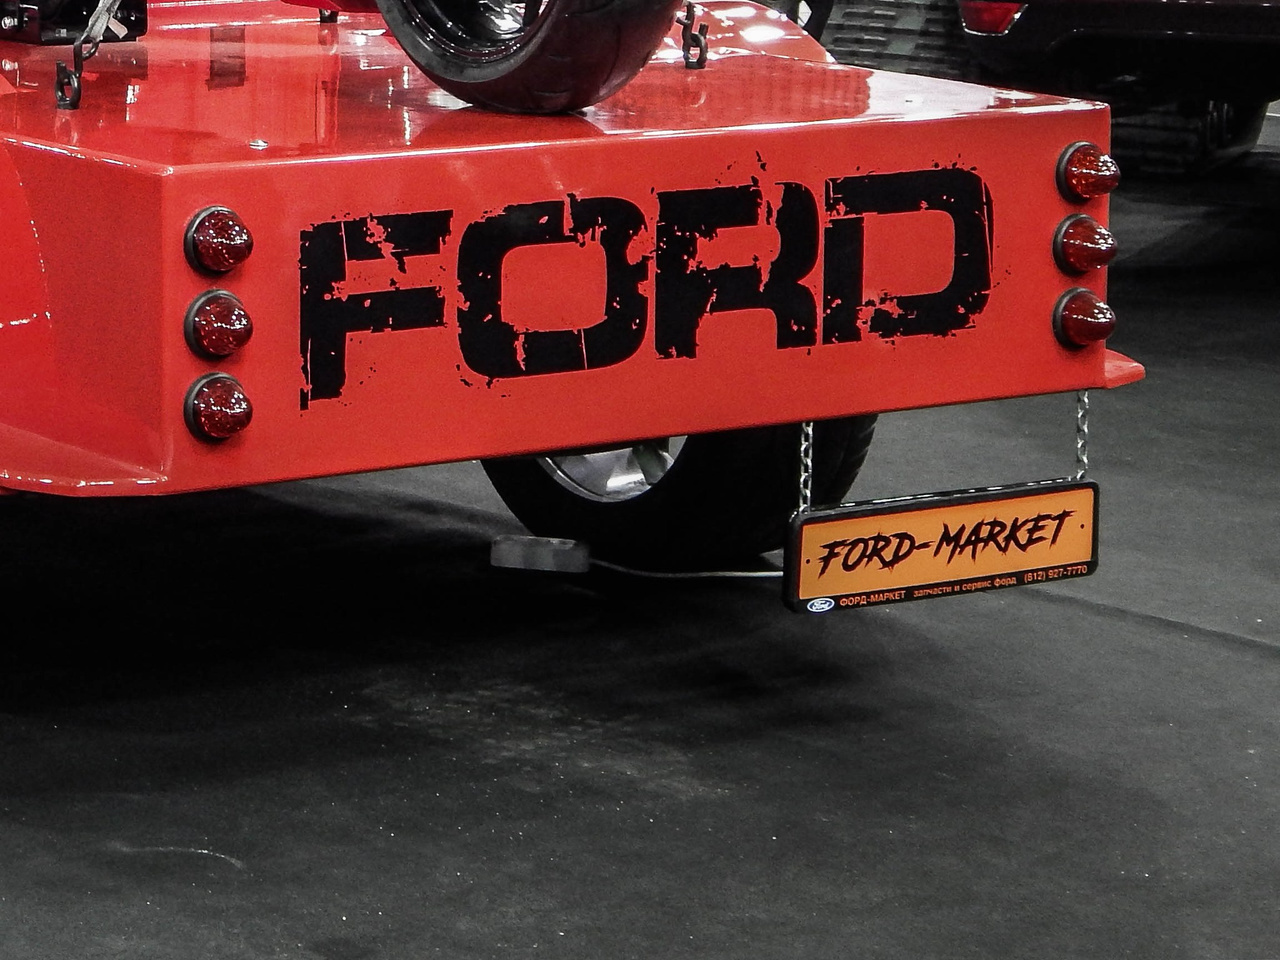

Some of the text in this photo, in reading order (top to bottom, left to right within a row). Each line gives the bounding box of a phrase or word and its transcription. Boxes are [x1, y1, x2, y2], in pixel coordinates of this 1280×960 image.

[300, 167, 994, 410] FORD
[818, 510, 1077, 580] FORD-MARKET
[839, 590, 906, 607] ФОРД-МАРКЕТ
[1048, 565, 1088, 579] 927-7770
